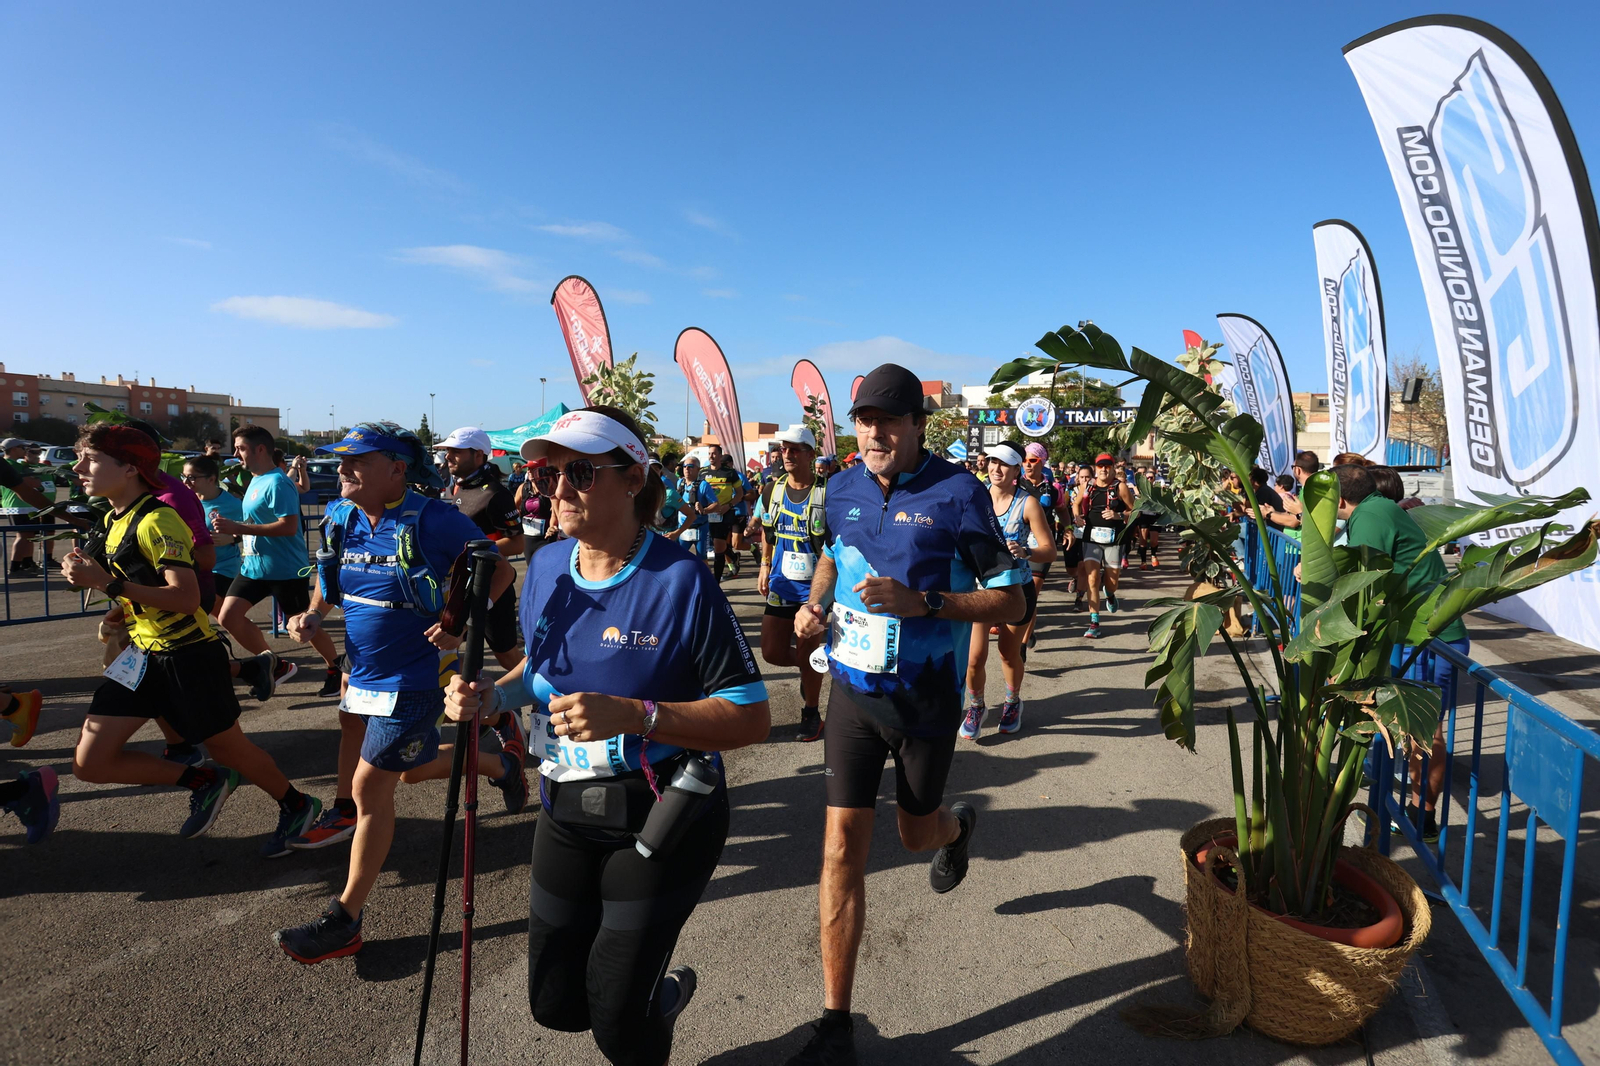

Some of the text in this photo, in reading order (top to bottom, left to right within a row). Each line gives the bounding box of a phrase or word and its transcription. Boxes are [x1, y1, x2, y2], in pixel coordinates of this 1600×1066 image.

[1065, 411, 1108, 423] TRAIL
[788, 561, 806, 571] 703
[840, 626, 871, 651] 536
[886, 623, 898, 670] PIRATILLA
[545, 743, 590, 770] 518
